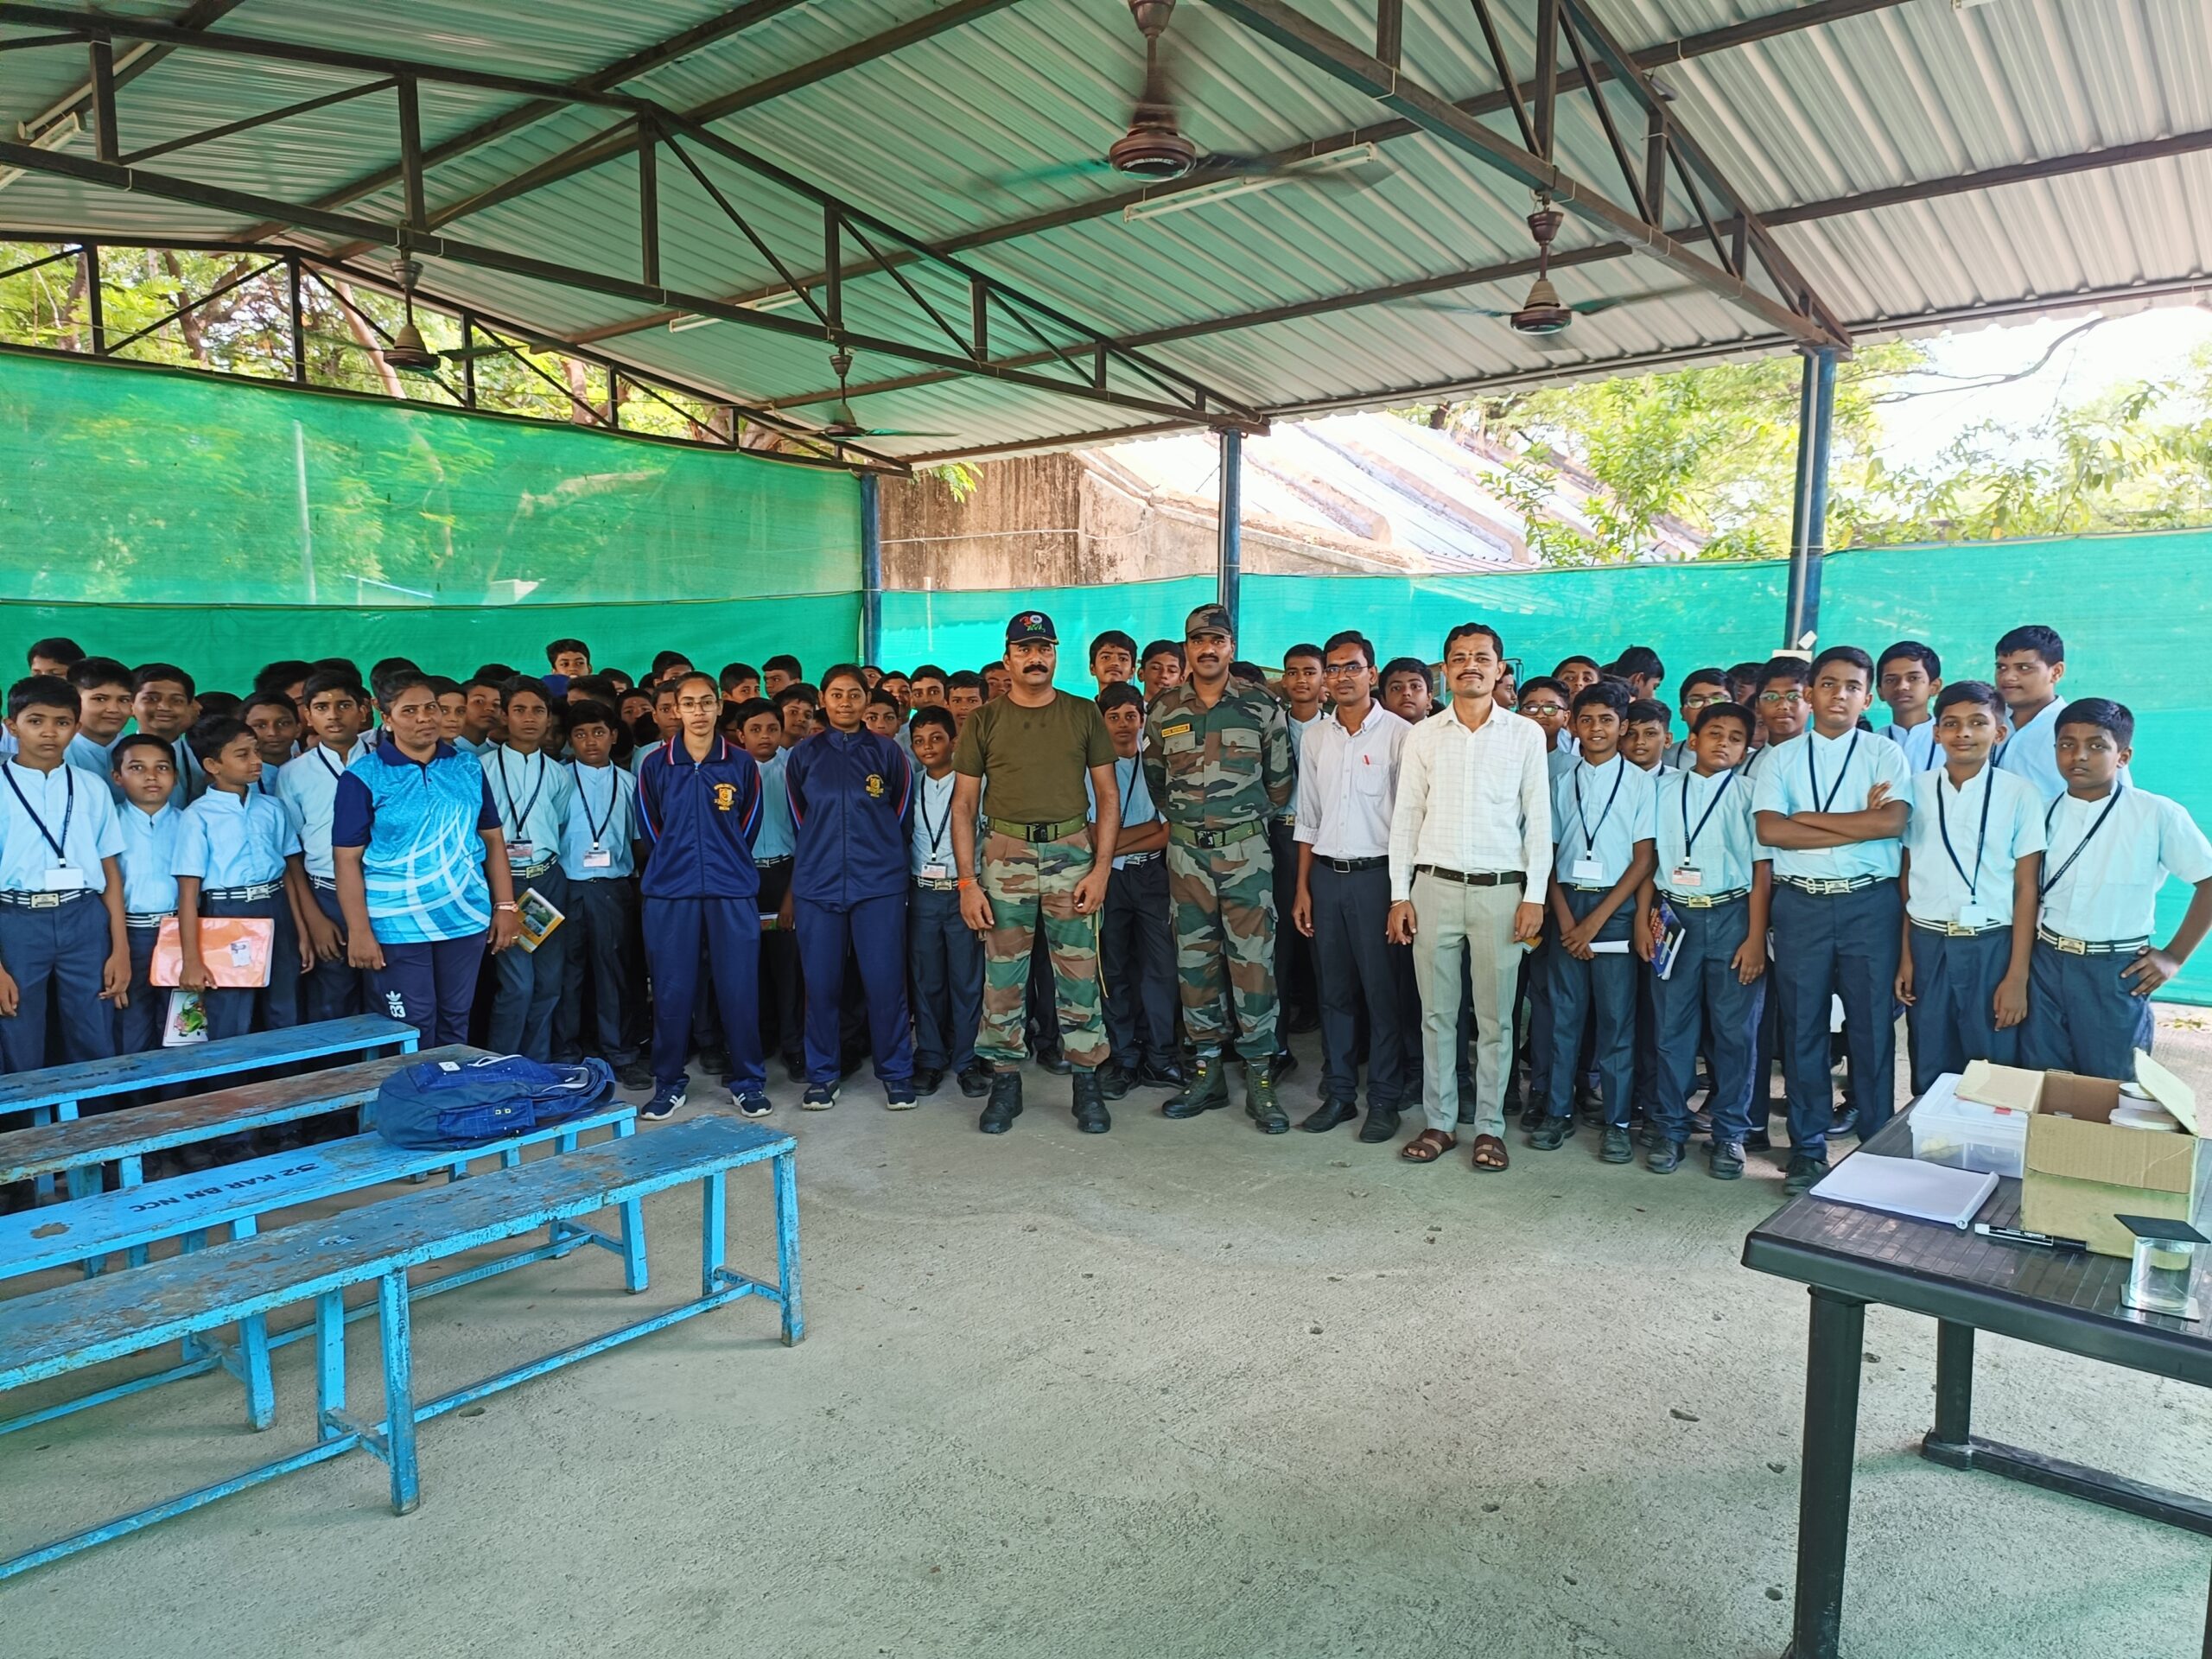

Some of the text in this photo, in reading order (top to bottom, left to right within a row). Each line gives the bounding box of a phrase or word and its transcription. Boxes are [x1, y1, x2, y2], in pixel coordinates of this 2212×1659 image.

[128, 1163, 320, 1213] 32 KAR BN NCC
